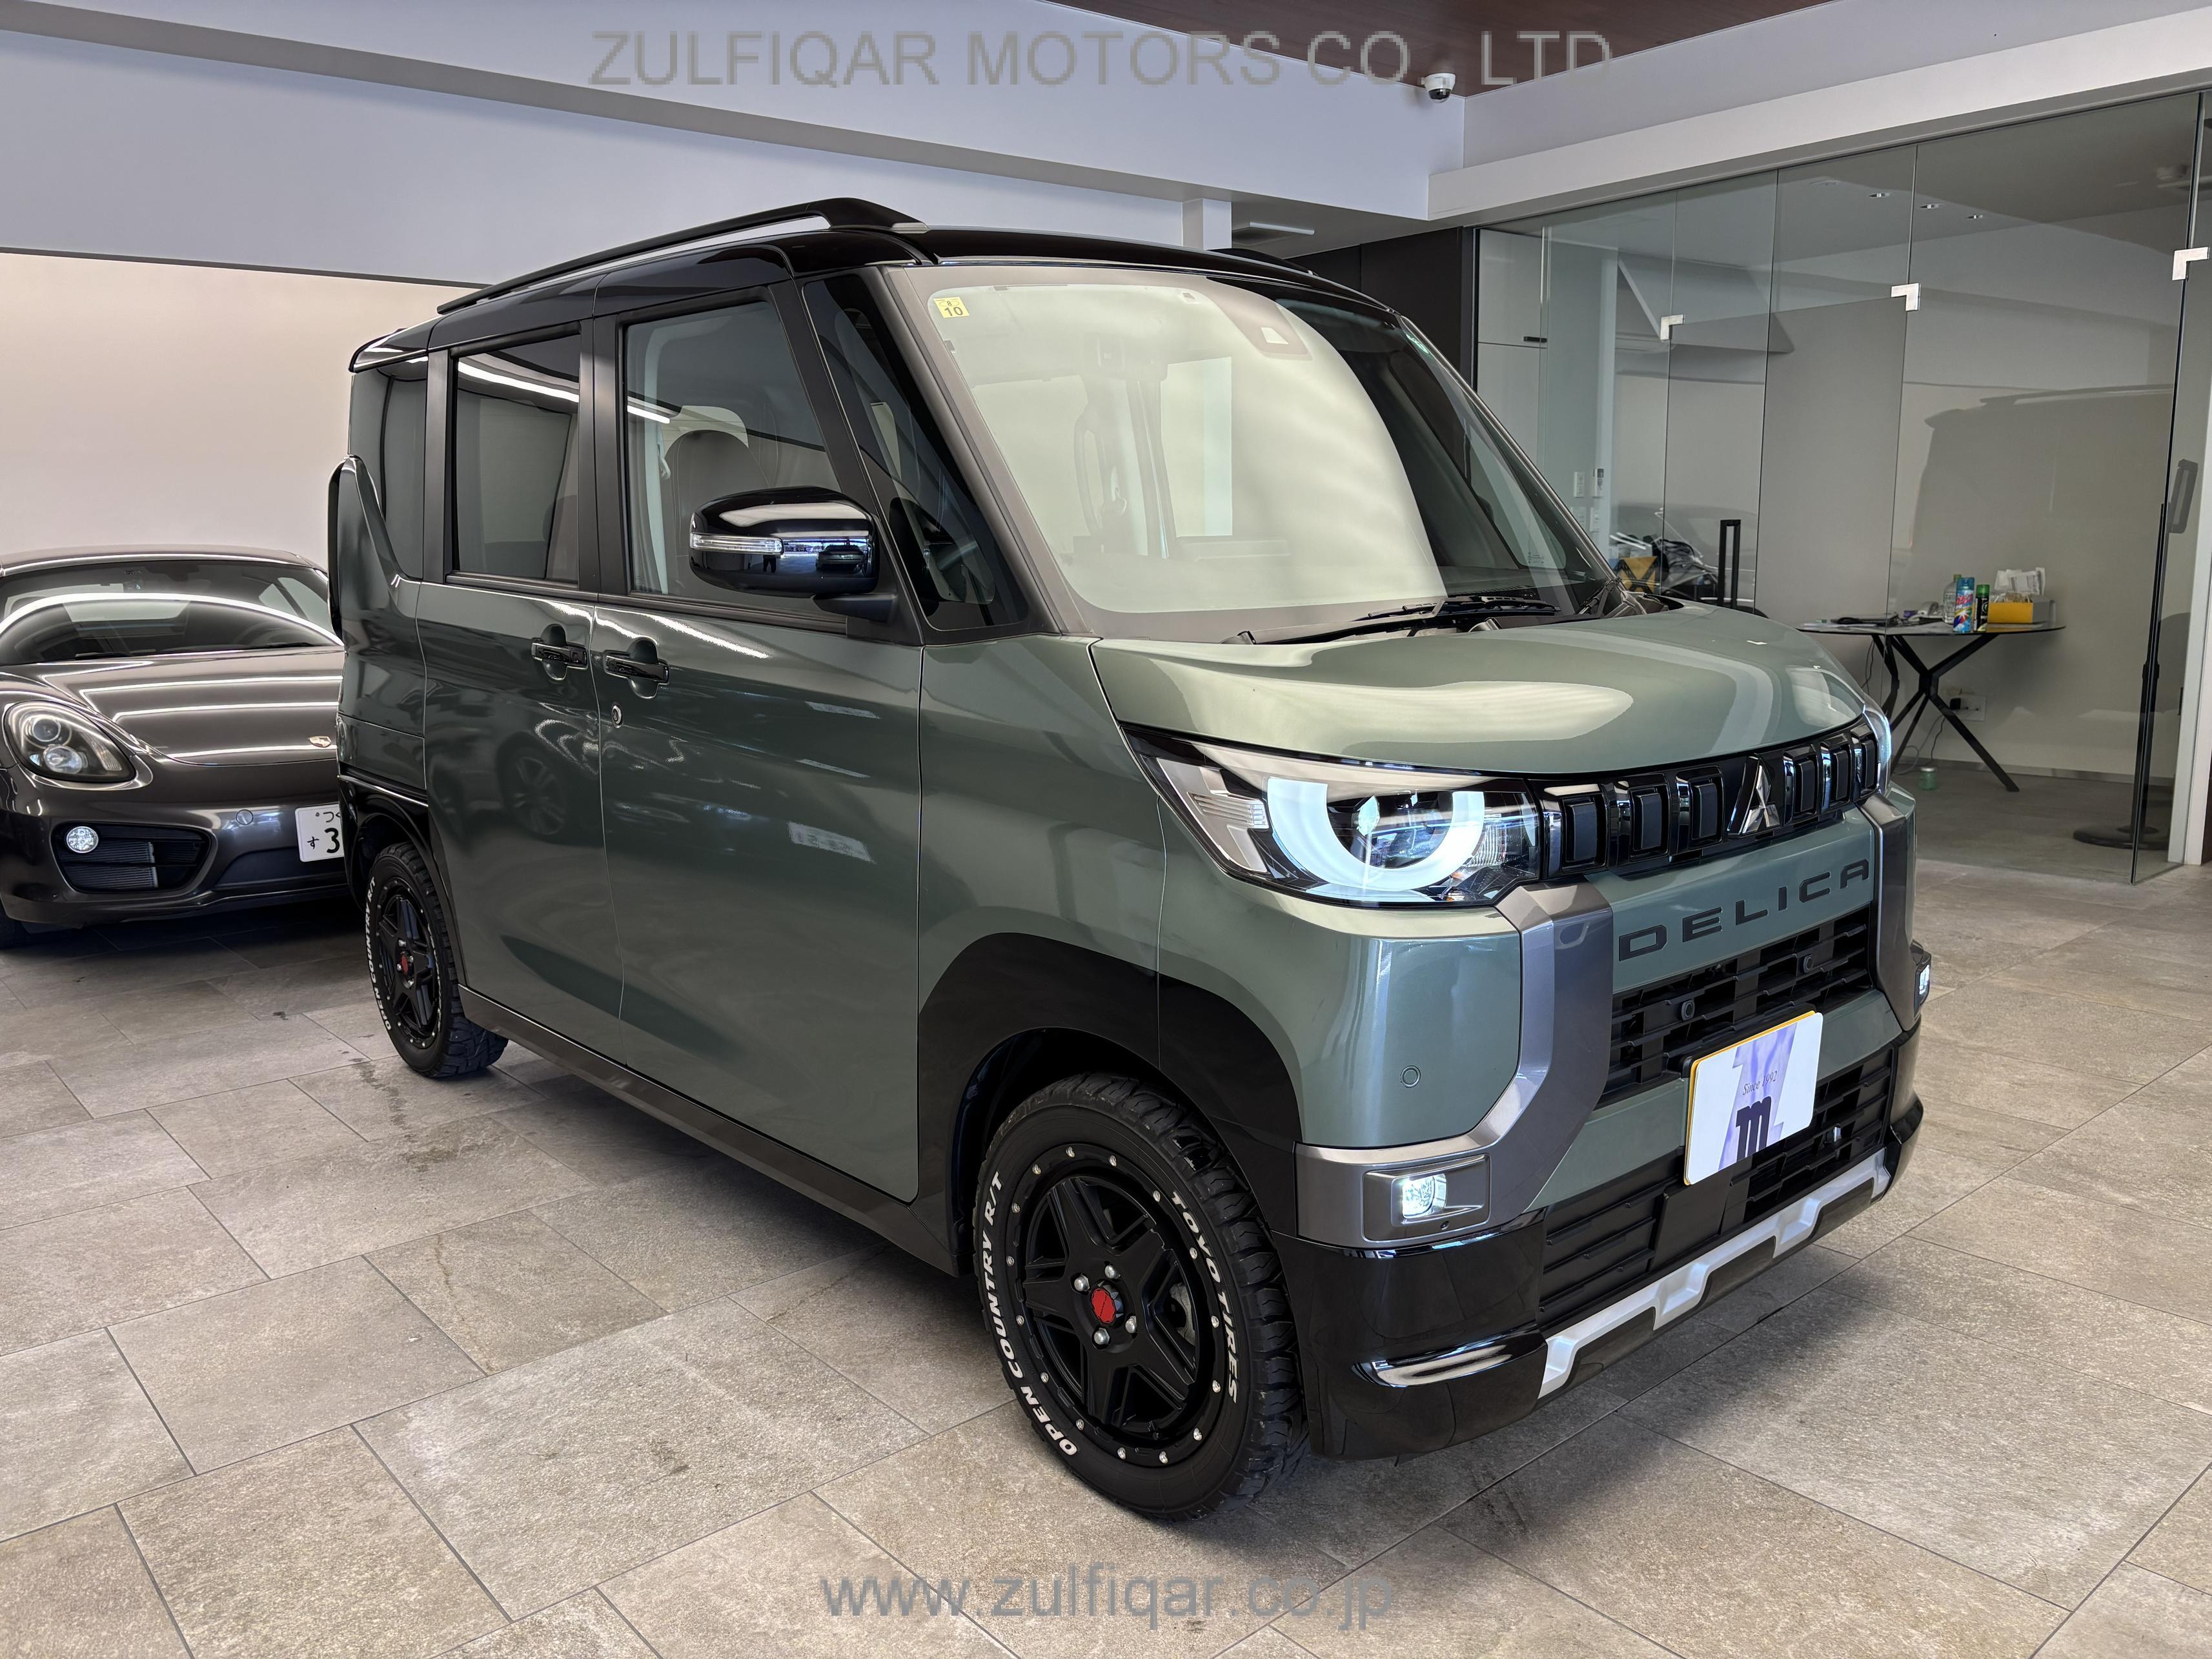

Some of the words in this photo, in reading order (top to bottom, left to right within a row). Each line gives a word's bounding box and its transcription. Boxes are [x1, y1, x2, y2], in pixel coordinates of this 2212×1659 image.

[944, 307, 963, 316] 10
[307, 836, 320, 850] す
[324, 827, 340, 853] 3
[1619, 859, 1869, 961] DELICA
[365, 902, 376, 983] COUNTRY
[374, 987, 391, 1030] OPEN
[1743, 1081, 1760, 1095] Since
[1762, 1070, 1778, 1087] 1992
[984, 1171, 1002, 1226] R/T
[982, 1230, 1024, 1378] COUNTRY
[1172, 1191, 1221, 1283] TOYO
[1217, 1290, 1238, 1403] TIRES
[1020, 1386, 1078, 1456] OPEN
